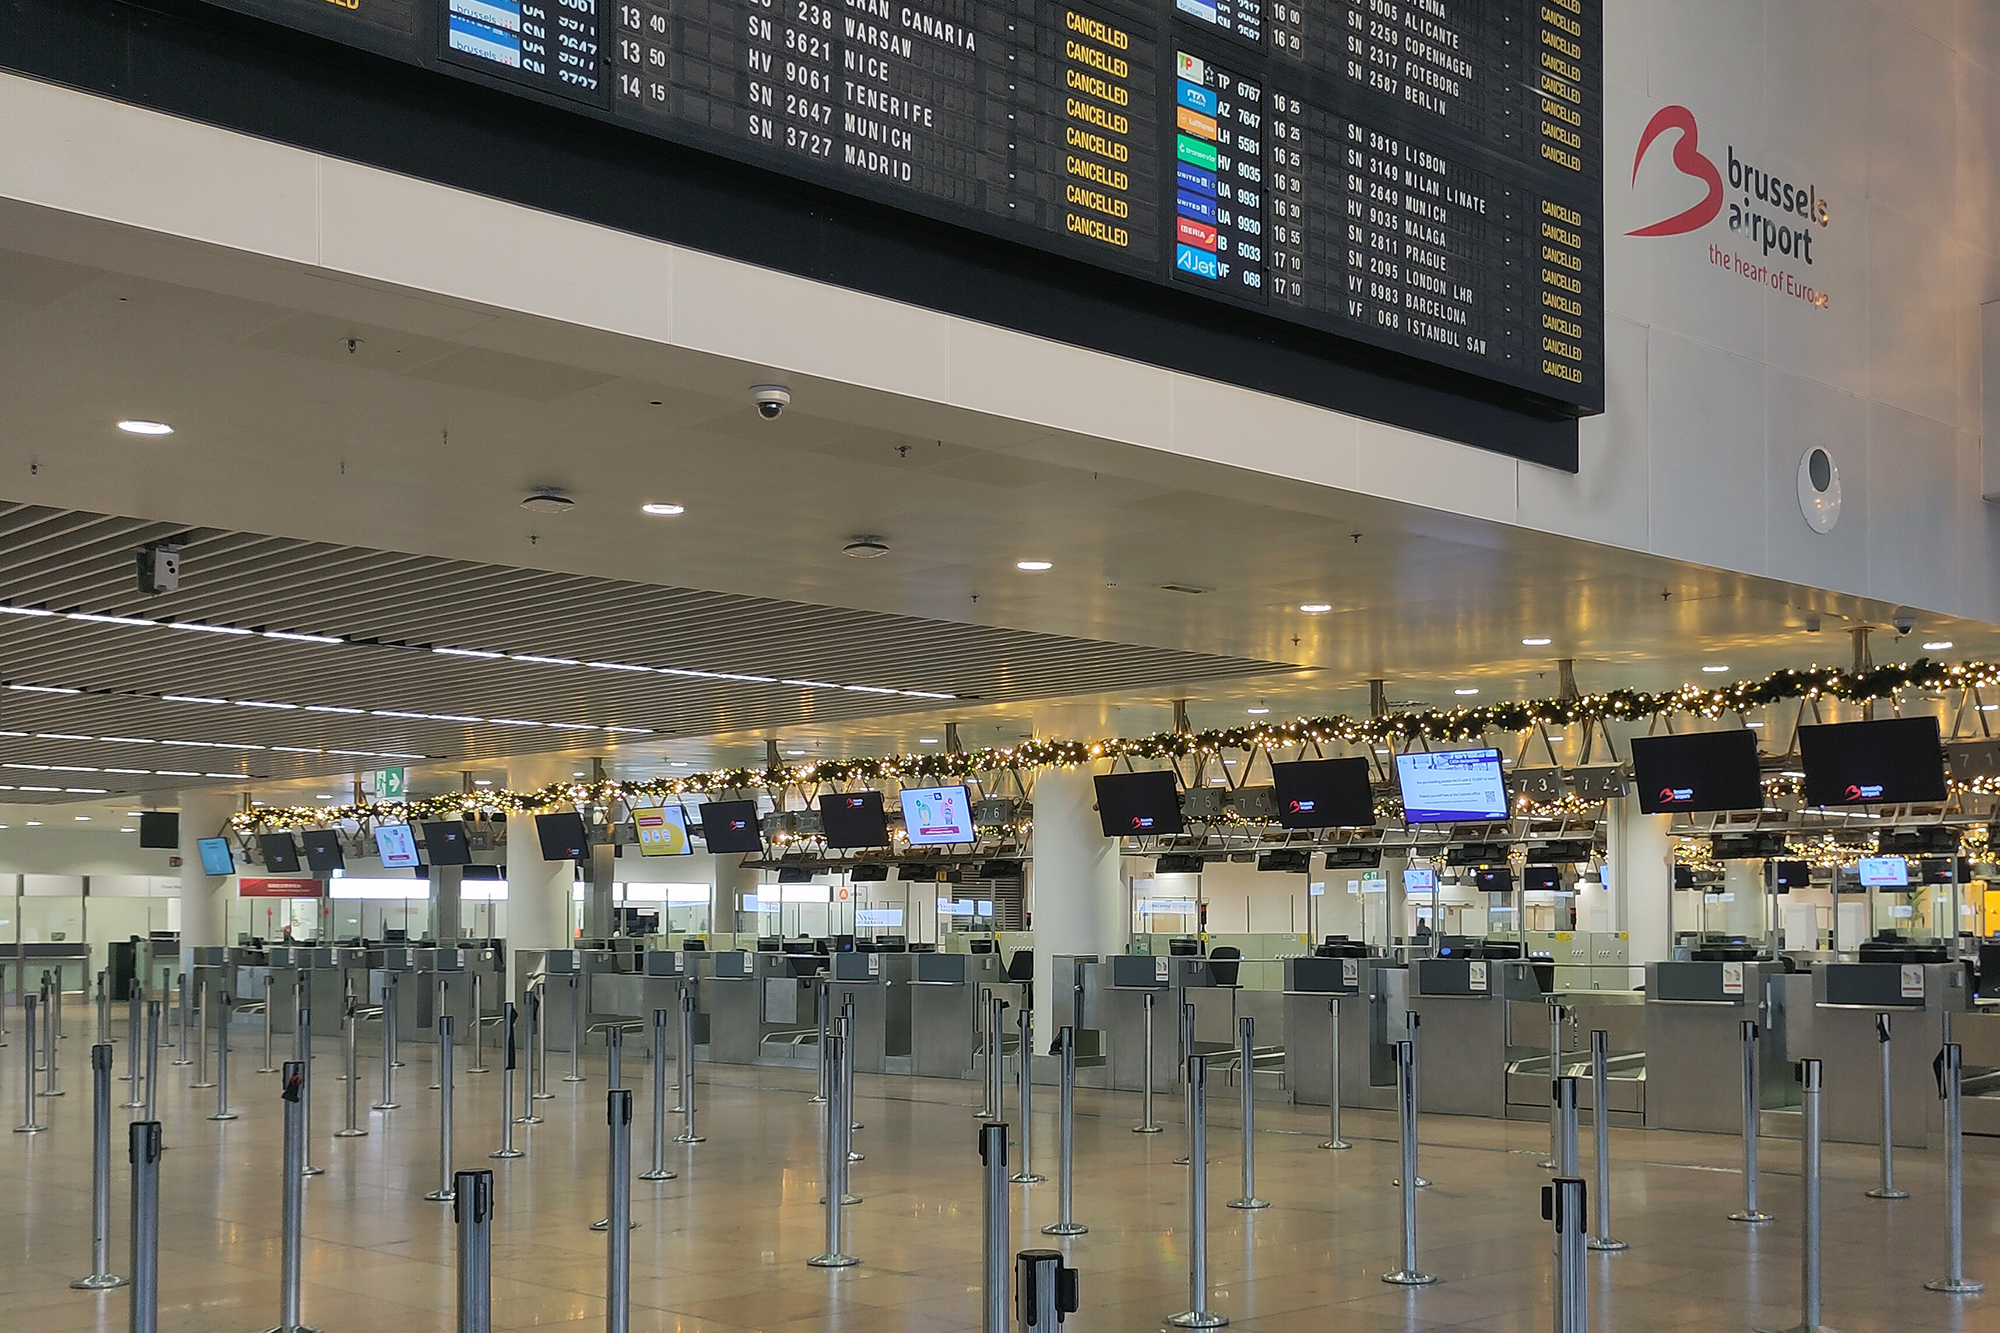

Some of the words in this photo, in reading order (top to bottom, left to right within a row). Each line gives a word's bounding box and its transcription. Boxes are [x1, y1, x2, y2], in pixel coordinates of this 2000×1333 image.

[798, 1, 831, 30] 238
[845, 17, 911, 59] WARSAW
[1066, 98, 1128, 134] CANCELLED
[902, 8, 975, 52] CANARIA
[1067, 69, 1128, 106] CANCELLED
[1066, 11, 1128, 50] CANCELLED
[1066, 40, 1128, 78] CANCELLED
[1348, 10, 1362, 30] SN
[1370, 21, 1398, 46] 2259
[1405, 36, 1472, 79] COPENHAGEN
[1542, 98, 1581, 126] CANCELLED
[1370, 0, 1397, 21] 9005
[1405, 12, 1458, 49] ALICANTE
[1541, 75, 1581, 104] CANCELLED
[1406, 0, 1446, 19] ENNA
[1542, 52, 1581, 82] CANCELLED
[1541, 6, 1581, 37] CANCELLED
[1542, 30, 1581, 59] CANCELLED
[621, 5, 640, 29] 13
[650, 14, 665, 33] 40
[749, 48, 772, 73] HV
[786, 62, 829, 93] 9061
[845, 81, 932, 127] TENERIFE
[1066, 156, 1128, 191] CANCELLED
[748, 16, 771, 41] SN
[786, 29, 829, 61] 3621
[845, 49, 888, 82] NICE
[1066, 127, 1128, 162] CANCELLED
[1217, 73, 1230, 90] TP
[1238, 82, 1261, 102] 6767
[1217, 101, 1231, 118] AZ
[1238, 108, 1261, 129] 7647
[1274, 3, 1286, 21] 16
[1290, 10, 1300, 24] 00
[1348, 36, 1362, 55] SN
[1370, 46, 1398, 70] 2317
[1542, 121, 1581, 149] CANCELLED
[1274, 29, 1285, 47] 16
[1290, 36, 1300, 50] 20
[1348, 61, 1362, 80] SN
[1370, 70, 1397, 94] 2587
[1405, 85, 1446, 115] BERLIN
[1541, 144, 1581, 171] CANCELLED
[620, 40, 640, 63] 13
[650, 48, 665, 67] 50
[749, 82, 772, 107] SN
[787, 94, 832, 125] 2647
[845, 112, 911, 151] MUNICH
[1066, 184, 1128, 218] CANCELLED
[620, 74, 640, 98] 14
[650, 83, 665, 101] 15
[749, 115, 772, 139] SN
[787, 127, 832, 157] 3727
[845, 144, 911, 181] MADRID
[1067, 214, 1128, 247] CANCELLED
[1217, 127, 1230, 145] LH
[1238, 135, 1259, 156] 5581
[1217, 154, 1231, 171] HV
[1238, 162, 1261, 182] 9035
[1274, 94, 1286, 112] 16
[1290, 100, 1300, 114] 25
[1348, 124, 1362, 143] SN
[1370, 132, 1398, 156] 3819
[1406, 146, 1446, 175] LISBON
[1542, 200, 1581, 226] CANCELLED
[1217, 181, 1231, 199] UA
[1238, 189, 1259, 209] 9931
[1217, 208, 1231, 226] UA
[1238, 215, 1261, 235] 9930
[1274, 120, 1286, 139] 16
[1290, 126, 1300, 141] 25
[1348, 149, 1362, 168] SN
[1370, 158, 1398, 181] 3149
[1405, 170, 1439, 197] MILAN
[1447, 186, 1485, 214] LINATE
[1542, 223, 1581, 249] CANCELLED
[1274, 146, 1286, 165] 16
[1290, 152, 1300, 167] 25
[1348, 174, 1362, 193] SN
[1370, 183, 1398, 206] 2649
[1406, 195, 1446, 223] MUNICH
[1542, 246, 1582, 271] CANCELLED
[1274, 173, 1286, 191] 16
[1290, 178, 1300, 193] 30
[1348, 199, 1362, 217] HV
[1370, 208, 1398, 230] 9035
[1405, 219, 1446, 247] MALAGA
[1542, 268, 1581, 294] CANCELLED
[1727, 145, 1829, 228] brussels
[1728, 197, 1813, 265] airport
[1217, 235, 1228, 251] IB
[1238, 242, 1261, 262] 5033
[1217, 261, 1230, 278] VF
[1243, 270, 1261, 288] 068
[1274, 199, 1286, 217] 16
[1290, 204, 1300, 218] 30
[1348, 224, 1362, 243] SN
[1371, 232, 1397, 255] 2811
[1406, 244, 1446, 271] PRAGUE
[1542, 291, 1582, 316] CANCELLED
[1274, 225, 1286, 243] 16
[1290, 230, 1300, 244] 55
[1348, 250, 1362, 268] SN
[1370, 258, 1398, 279] 2095
[1406, 269, 1446, 295] LONDON
[1454, 285, 1472, 304] LHR
[1542, 314, 1582, 338] CANCELLED
[1709, 243, 1731, 271] the
[1734, 252, 1768, 286] heart
[1771, 270, 1784, 290] of
[1786, 274, 1829, 309] Europe
[1274, 251, 1286, 268] 17
[1291, 256, 1300, 270] 10
[1349, 275, 1362, 293] VY
[1371, 282, 1398, 304] 8983
[1406, 293, 1466, 325] BARCELONA
[1543, 337, 1582, 361] CANCELLED
[1274, 277, 1286, 294] 17
[1291, 282, 1301, 296] 10
[1349, 300, 1363, 317] VF
[1378, 310, 1399, 329] 068
[1408, 318, 1460, 347] ISTANBUL
[1467, 336, 1486, 355] SAW
[1543, 360, 1582, 383] CANCELLED
[1520, 778, 1548, 792] 7.3
